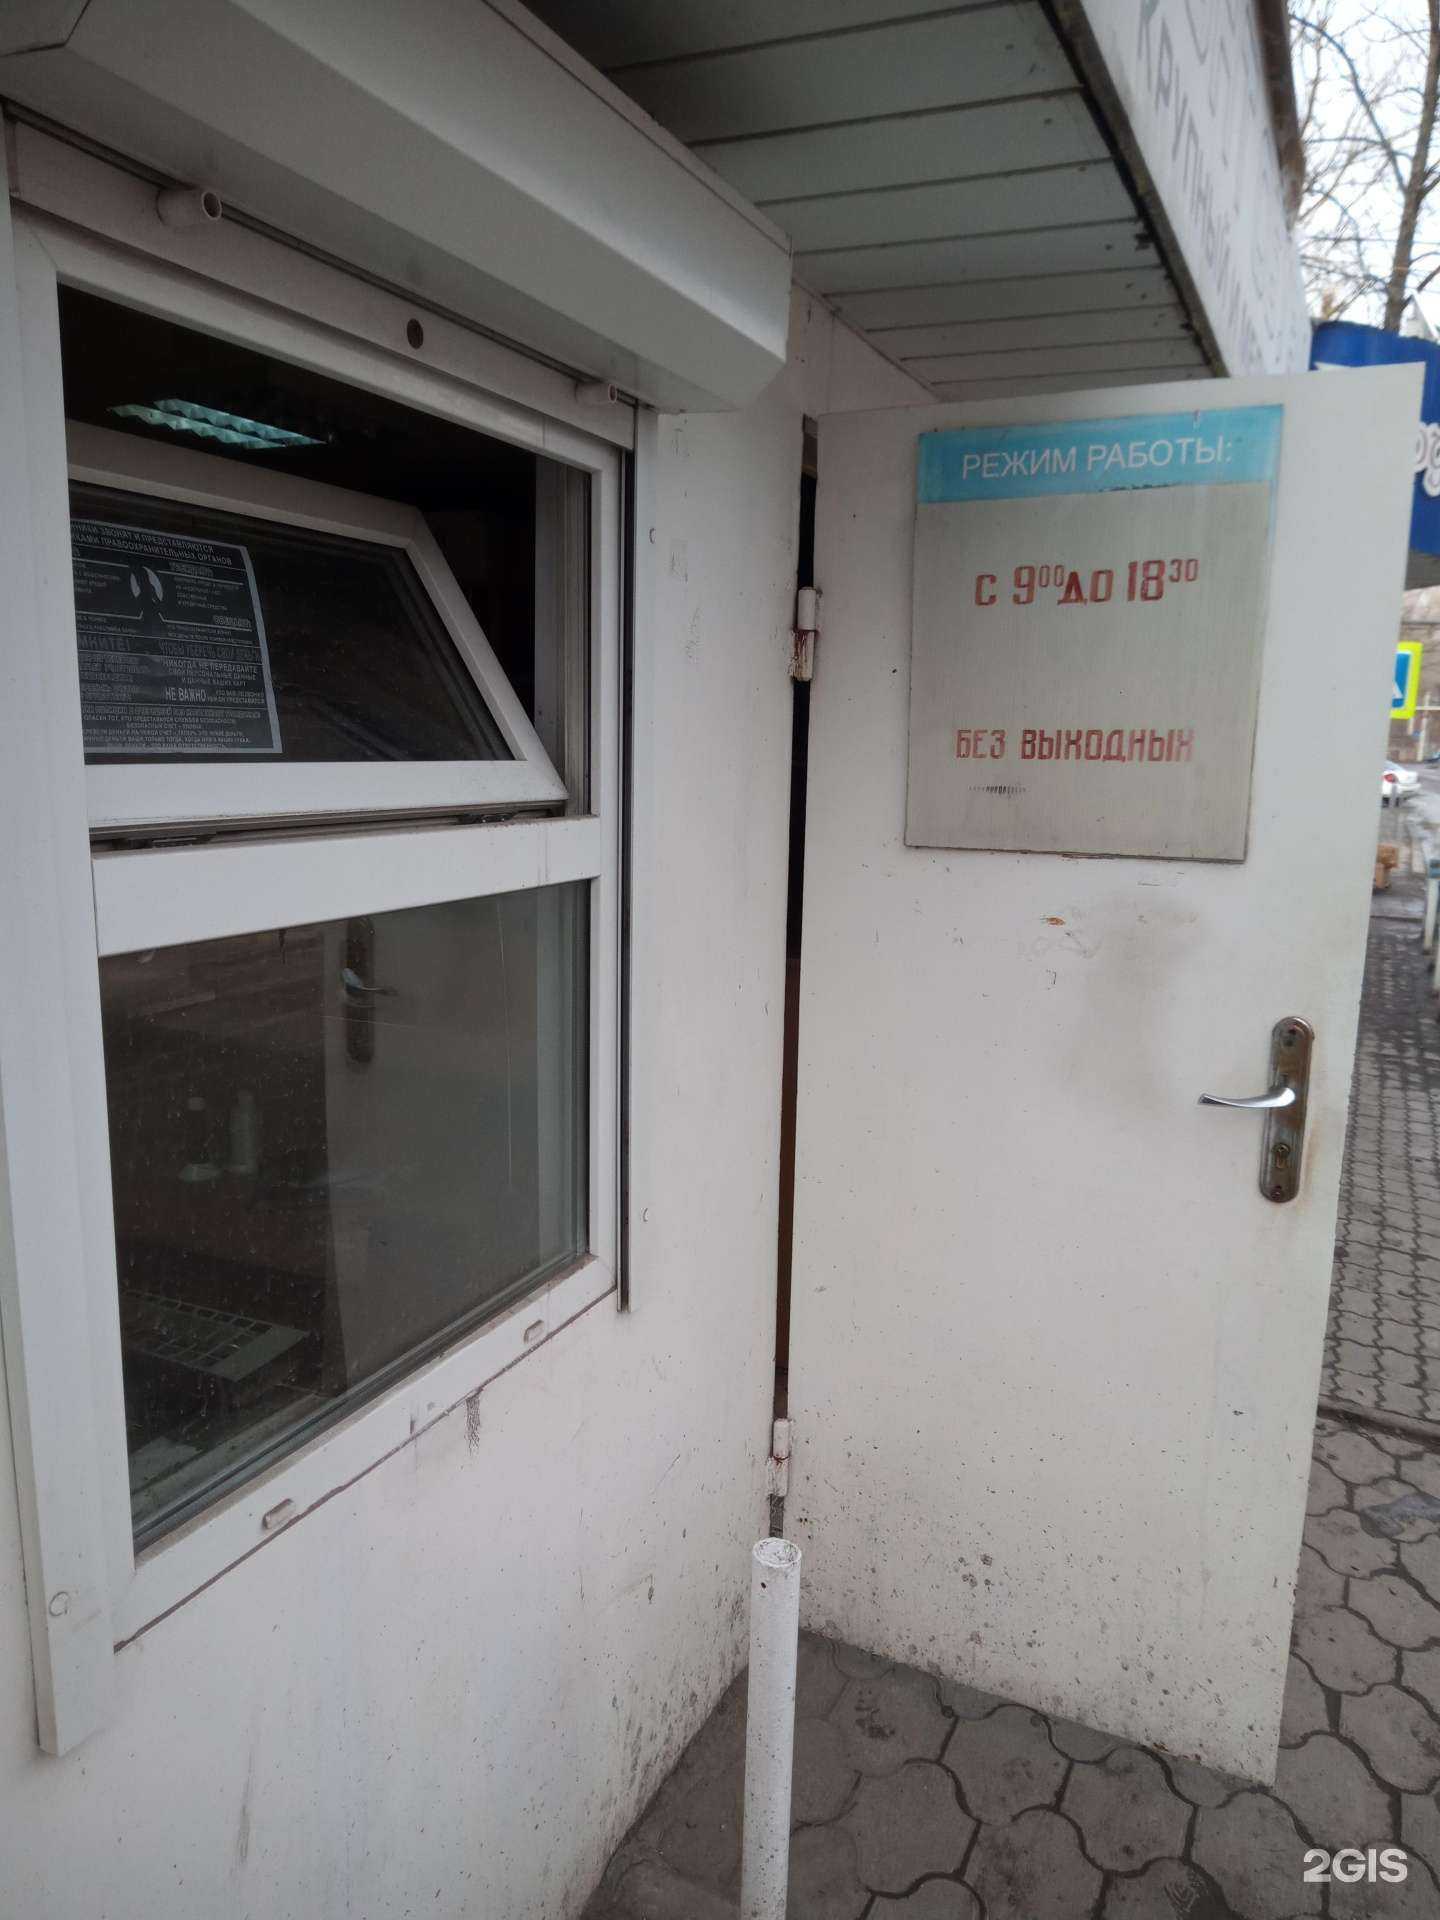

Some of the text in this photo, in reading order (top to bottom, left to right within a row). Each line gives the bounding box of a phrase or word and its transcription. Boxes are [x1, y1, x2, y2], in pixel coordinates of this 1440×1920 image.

[962, 437, 1232, 480] РЕЖИМ РАБОТЫ:
[975, 574, 997, 606] С
[164, 687, 177, 700] НЕ
[177, 688, 207, 702] ВАЖНО
[956, 729, 1195, 763] БЕЗ ВЫХОДНЫХ
